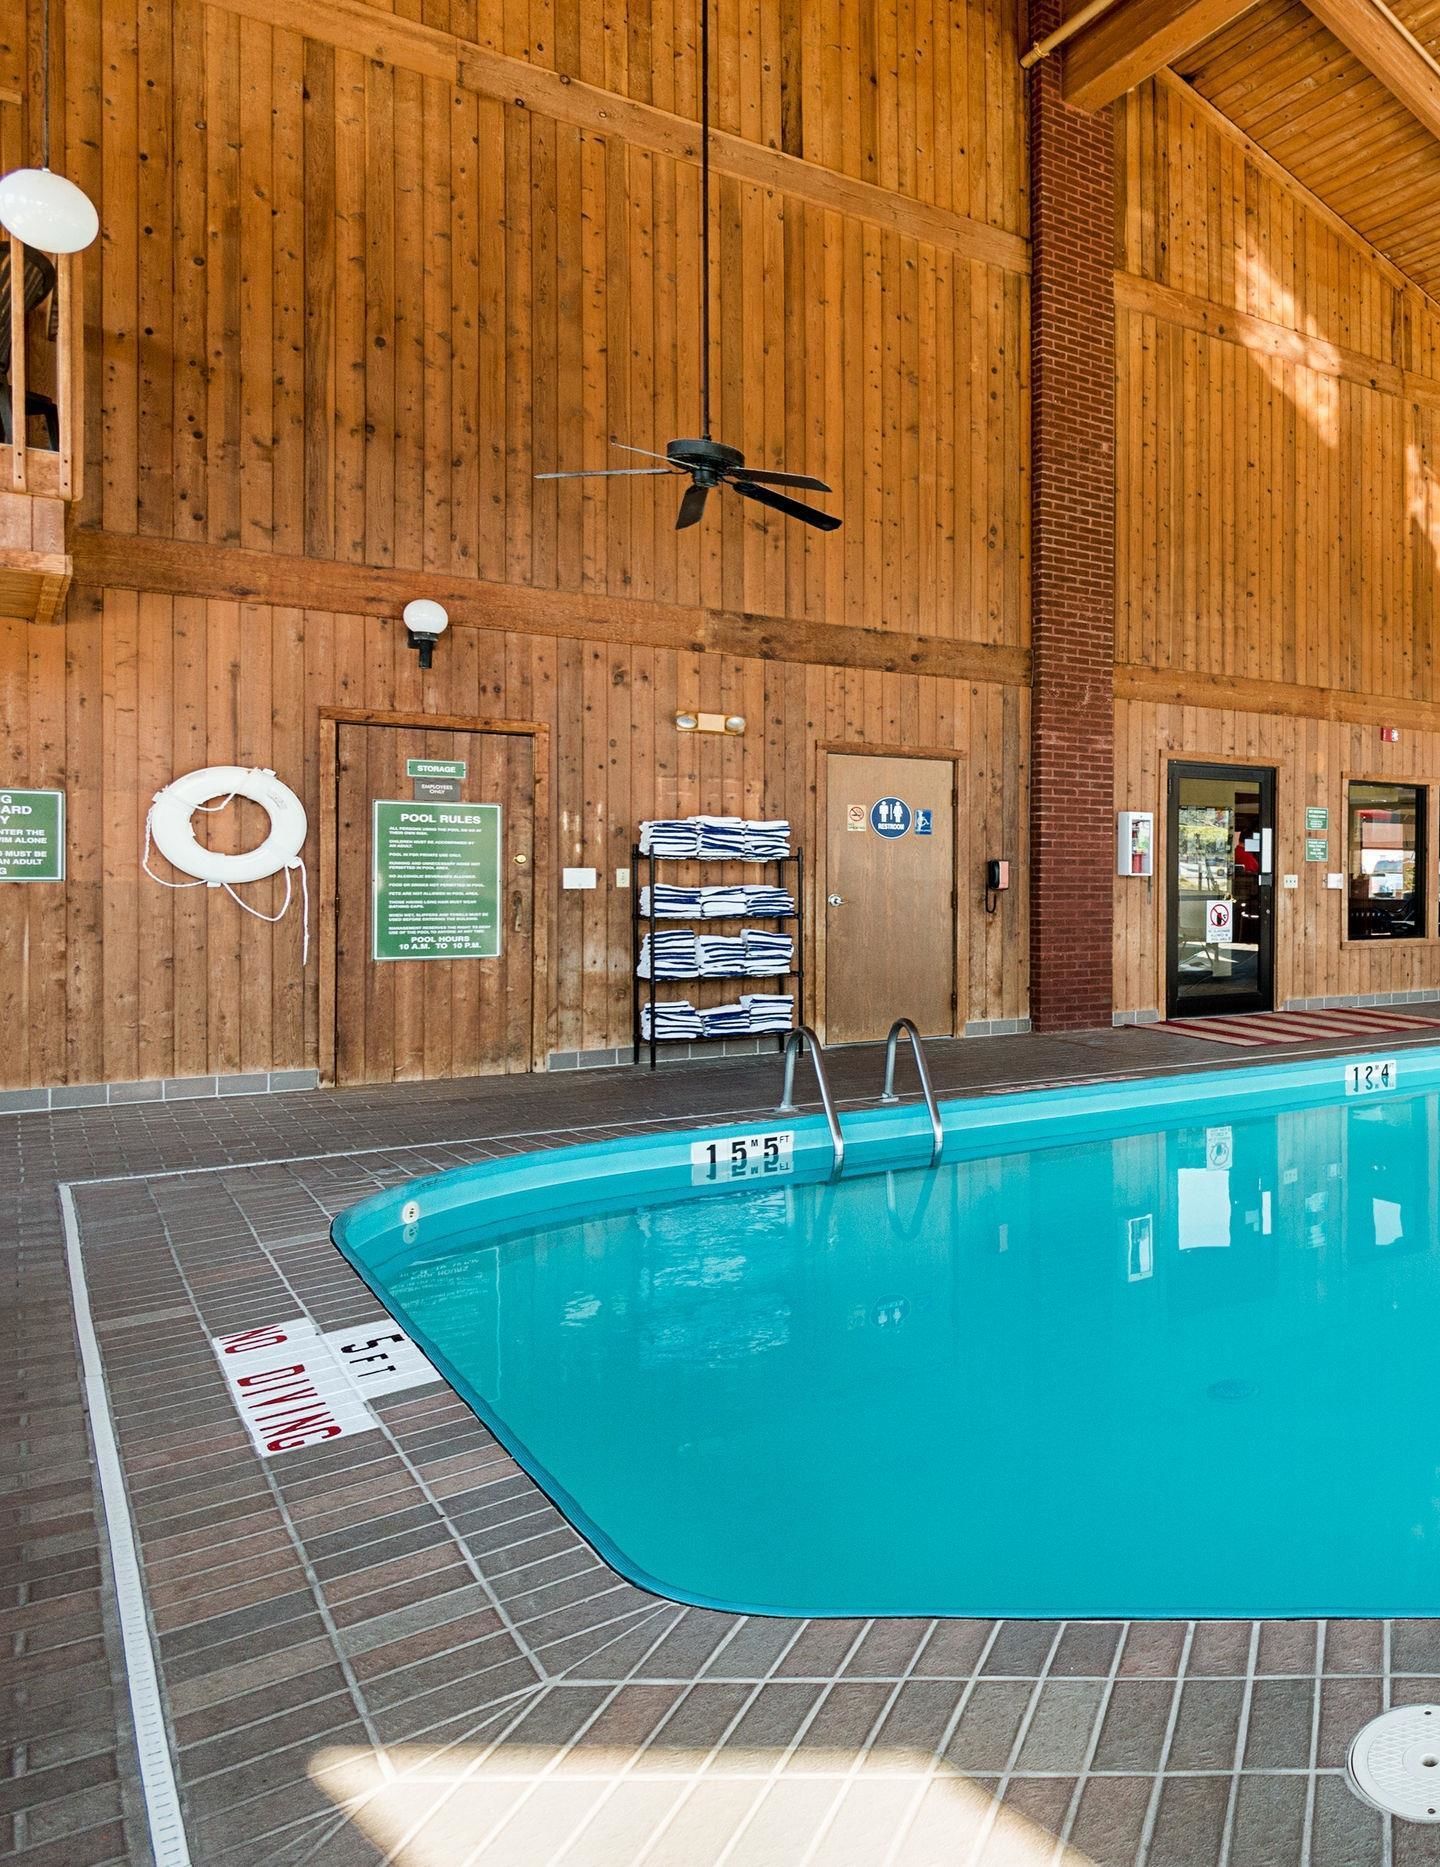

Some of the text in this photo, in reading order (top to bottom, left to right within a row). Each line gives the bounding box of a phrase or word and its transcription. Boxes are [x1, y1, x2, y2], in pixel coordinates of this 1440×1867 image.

[417, 765, 456, 773] STORAGE
[400, 813, 481, 824] POOL RULES
[751, 1139, 758, 1147] M
[779, 1135, 790, 1144] FT
[219, 1324, 342, 1452] NO DIVING
